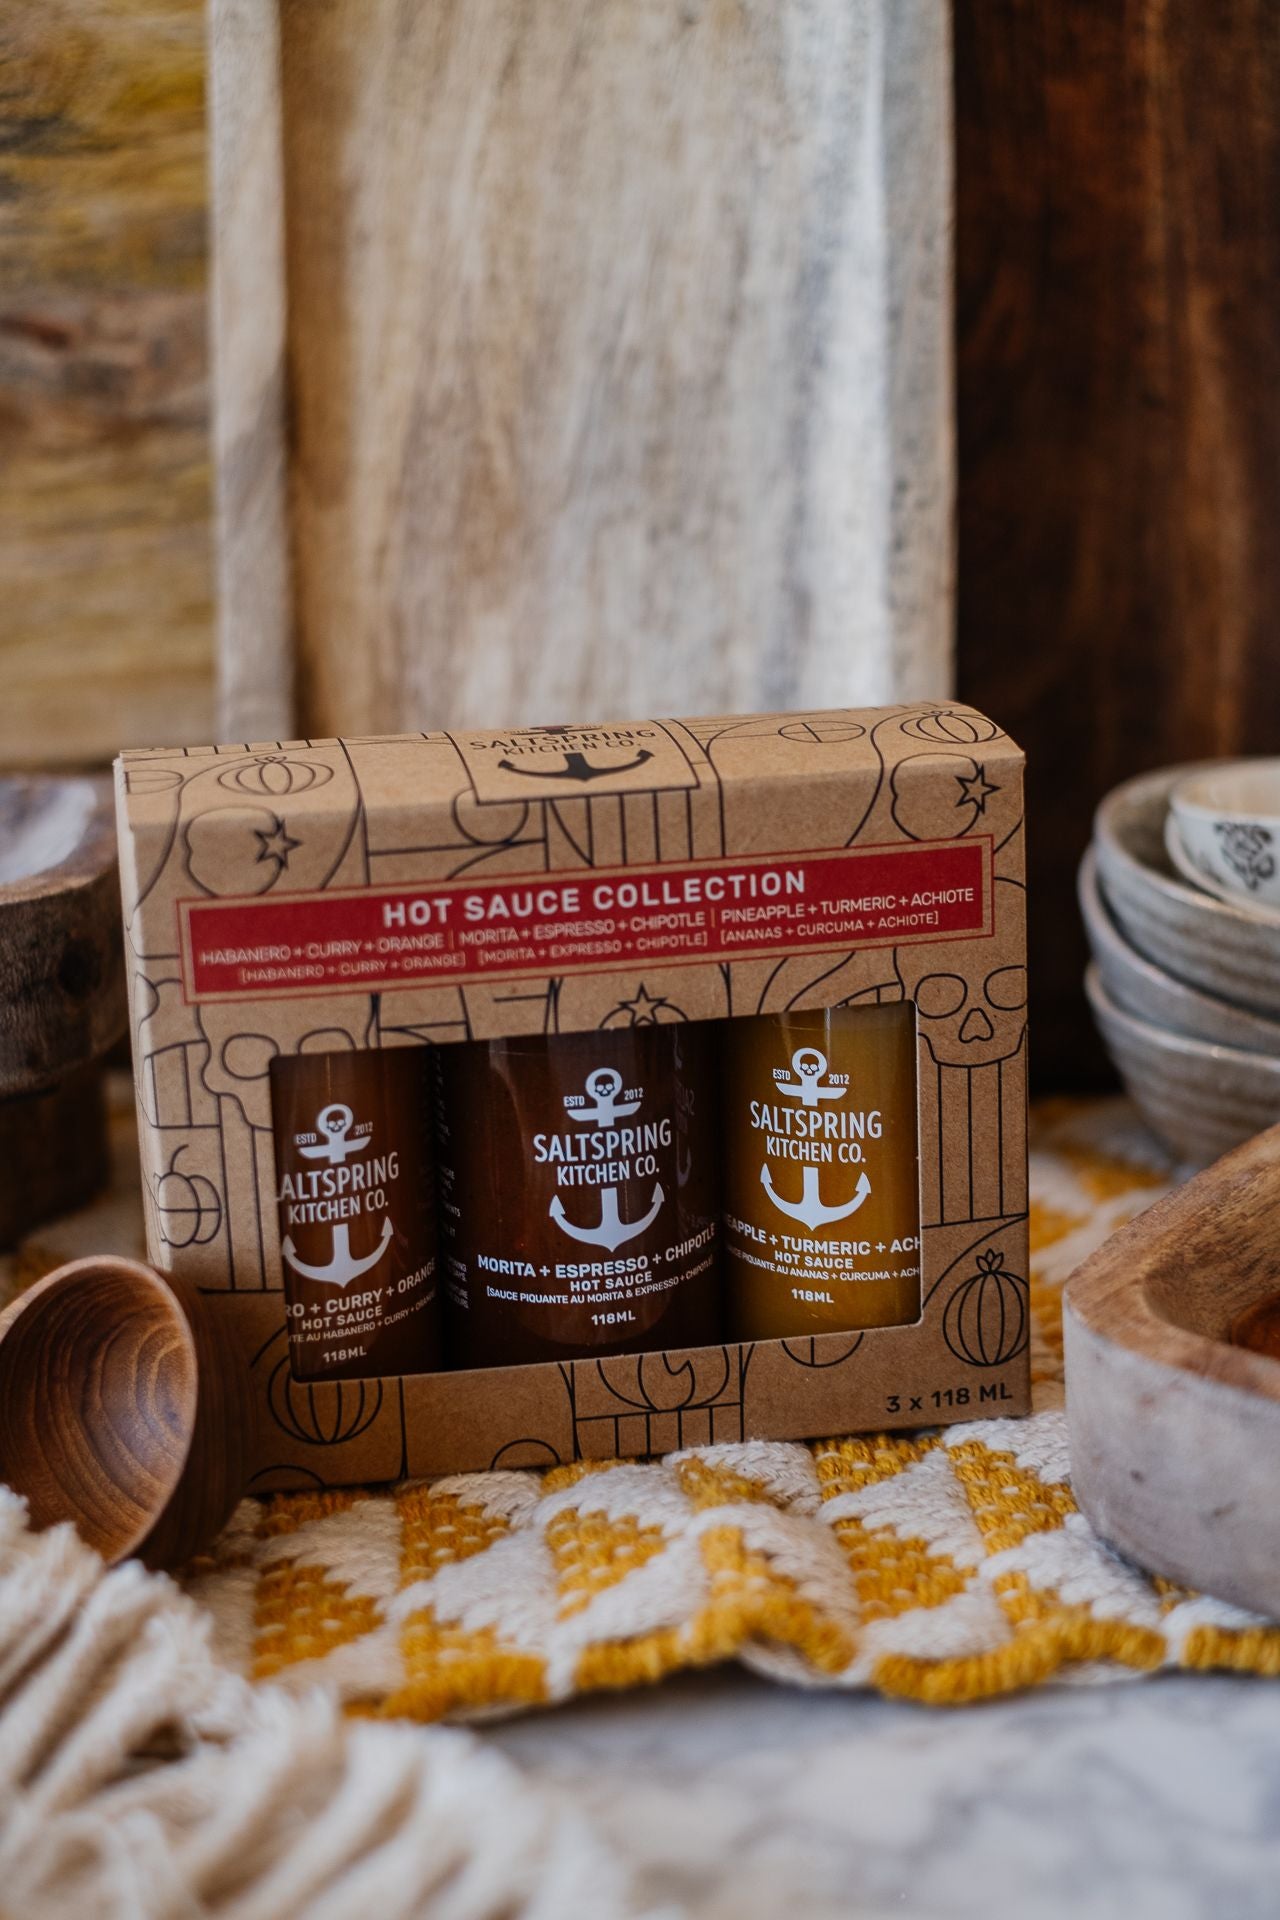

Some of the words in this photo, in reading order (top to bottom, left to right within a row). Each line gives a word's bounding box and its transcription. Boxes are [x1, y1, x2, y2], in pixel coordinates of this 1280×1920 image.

[469, 729, 656, 750] SALTSPRING
[502, 742, 598, 756] KITCHEN
[382, 898, 453, 928] HOT
[464, 887, 581, 921] SAUCE
[593, 870, 805, 909] COLLECTION
[201, 944, 291, 966] HABANERO
[292, 945, 304, 957] +
[306, 939, 362, 959] CURRY
[364, 941, 376, 951] +
[378, 932, 444, 952] ORANGE
[459, 927, 519, 946] MORITA
[521, 928, 532, 939] +
[534, 919, 616, 941] ESPRESSO
[618, 920, 628, 930] +
[630, 911, 705, 932] CHIPOTLE
[721, 903, 805, 923] PINEAPPLE
[808, 904, 818, 915] +
[820, 895, 896, 915] TURMERIC
[898, 895, 909, 907] +
[910, 887, 974, 908] ACHIOTE
[341, 959, 387, 975] CURRY
[550, 940, 622, 959] EXPRESSO
[636, 933, 708, 952] CHIPOTLE]
[720, 926, 782, 945] [ANANAS
[785, 927, 794, 936] +
[797, 919, 864, 937] CURCUMA
[866, 920, 875, 929] +
[877, 910, 939, 929] ACHIOTE]
[772, 1068, 791, 1081] ESTD
[829, 1073, 850, 1085] 2012
[563, 1095, 585, 1107] ESTD
[624, 1087, 644, 1101] 2012
[296, 1133, 317, 1144] ESTD
[355, 1121, 374, 1136] 2012
[750, 1100, 882, 1139] SALTSPRING
[533, 1118, 672, 1163] SALTSPRING
[766, 1135, 833, 1163] KITCHEN
[838, 1143, 866, 1163] CO.
[277, 1151, 400, 1201] ALTSPRING
[557, 1160, 630, 1186] KITCHEN
[635, 1155, 660, 1177] CO.
[288, 1195, 361, 1225] KITCHEN
[365, 1188, 389, 1212] CO.
[477, 1254, 536, 1278] MORITA
[539, 1265, 550, 1277] +
[555, 1255, 649, 1279] ESPRESSO
[652, 1253, 662, 1265] +
[665, 1222, 716, 1262] CHIPOTLE
[769, 1233, 779, 1246] +
[781, 1235, 870, 1256] TURMERIC
[875, 1242, 886, 1253] +
[774, 1250, 800, 1265] HOT
[805, 1256, 854, 1270] SAUCE
[776, 1265, 788, 1275] AU
[790, 1268, 829, 1281] ANANAS
[839, 1271, 890, 1281] CURCUMA
[520, 1293, 569, 1305] PIQUANTE
[570, 1295, 585, 1304] AU
[587, 1291, 624, 1303] MORITA
[635, 1277, 679, 1297] EXPRESSO
[570, 1279, 600, 1292] HOT
[605, 1271, 653, 1290] SAUCE
[310, 1303, 321, 1315] +
[326, 1288, 383, 1313] CURRY
[791, 1288, 834, 1304] 118ML
[302, 1316, 332, 1331] HOT
[337, 1305, 383, 1326] SAUCE
[306, 1331, 321, 1342] AU
[323, 1320, 376, 1340] HABANERO
[384, 1309, 409, 1326] CURRY
[591, 1310, 636, 1326] 118ML
[322, 1345, 367, 1363] 118ML
[886, 1395, 901, 1413] 3
[931, 1387, 970, 1408] 118
[979, 1382, 1013, 1402] ML
